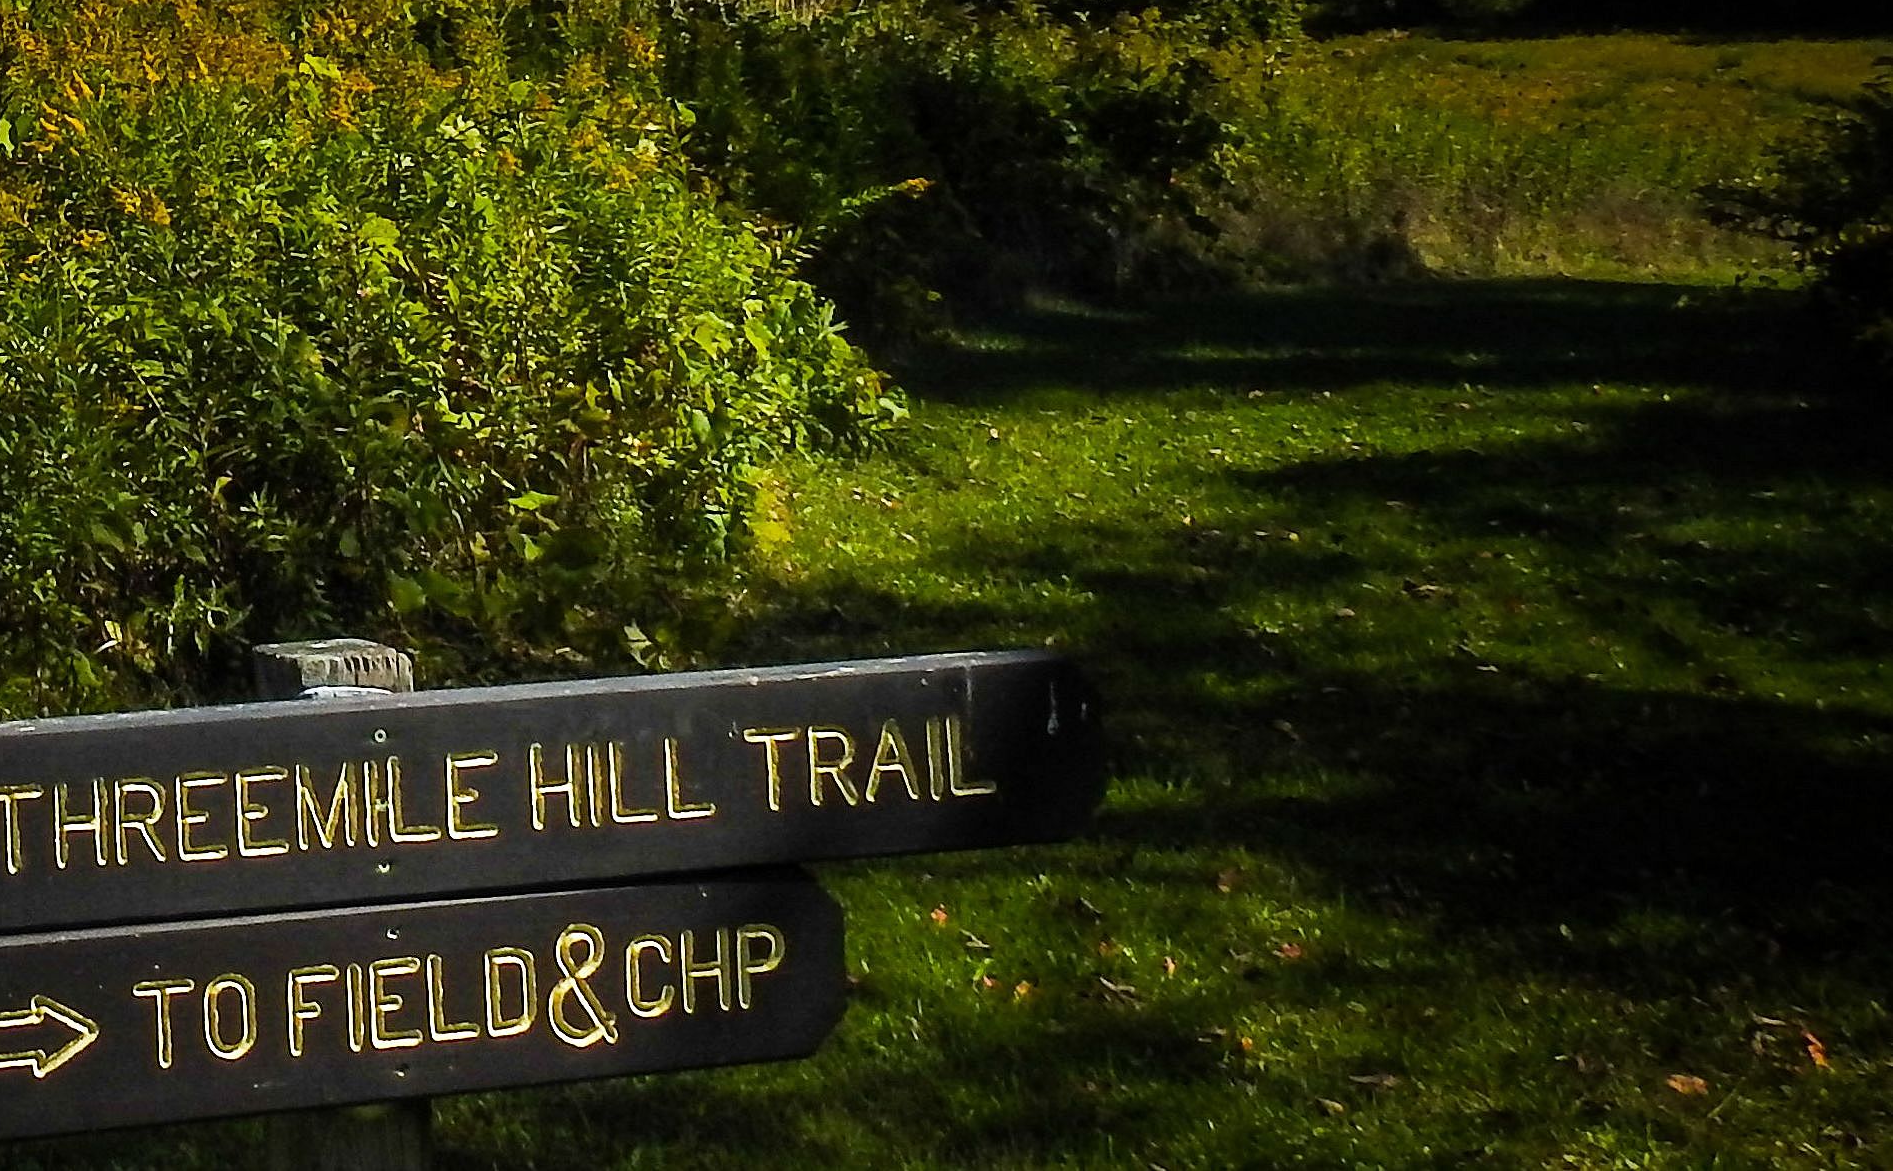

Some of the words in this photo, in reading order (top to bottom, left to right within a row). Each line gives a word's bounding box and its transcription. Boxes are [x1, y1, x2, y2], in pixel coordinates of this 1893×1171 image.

[529, 738, 716, 832] HILL
[743, 714, 997, 812] TRAIL
[132, 972, 256, 1068] TO
